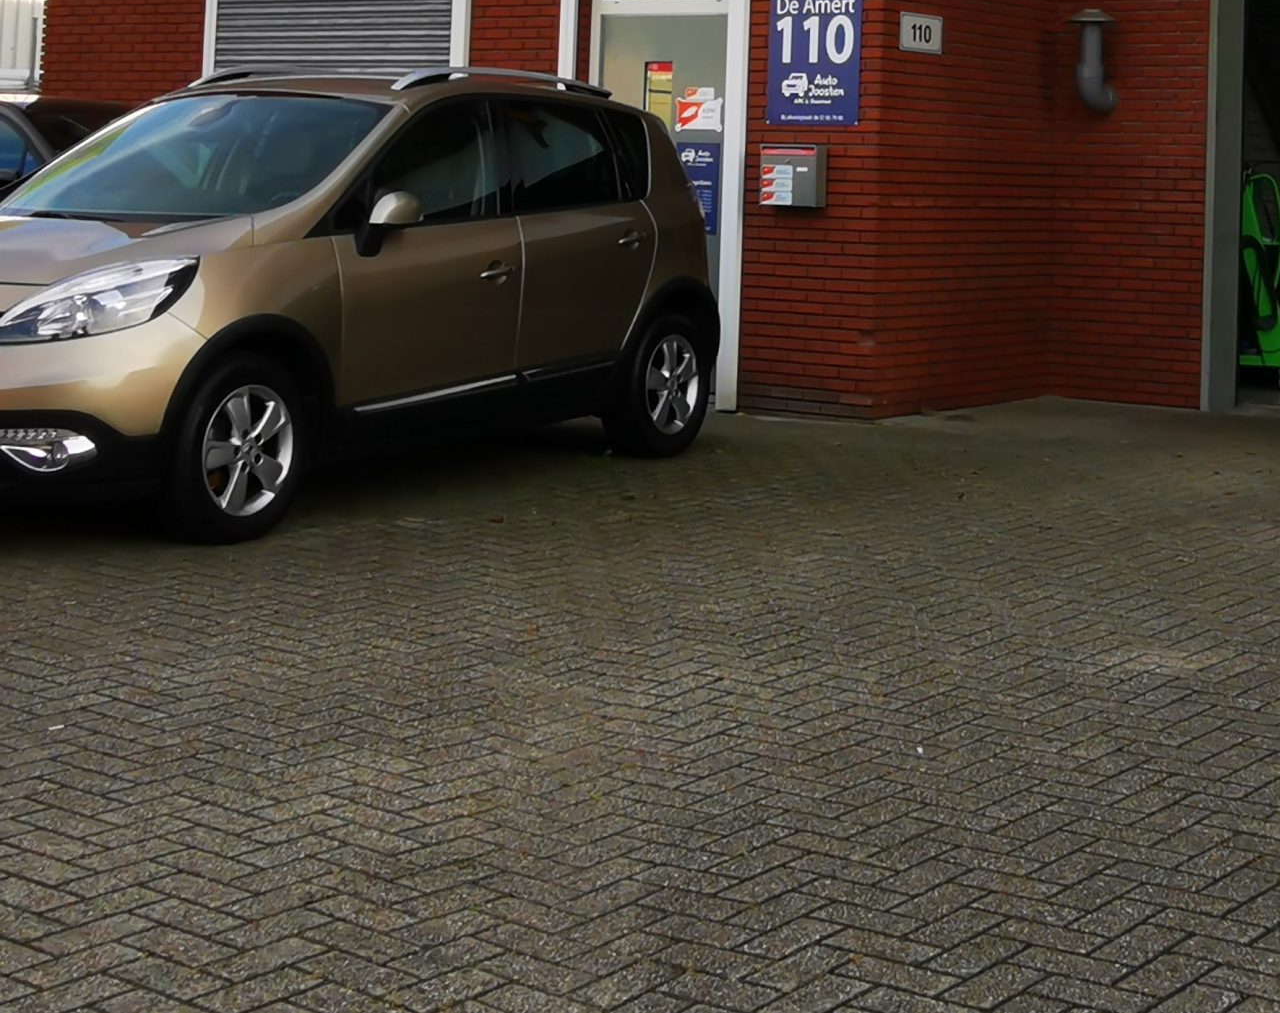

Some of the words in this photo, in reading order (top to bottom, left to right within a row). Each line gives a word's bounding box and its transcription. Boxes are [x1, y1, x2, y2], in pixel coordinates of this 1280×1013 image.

[776, 14, 855, 65] 110
[911, 23, 932, 44] 110
[814, 73, 839, 86] Auto
[808, 84, 845, 97] Joosten
